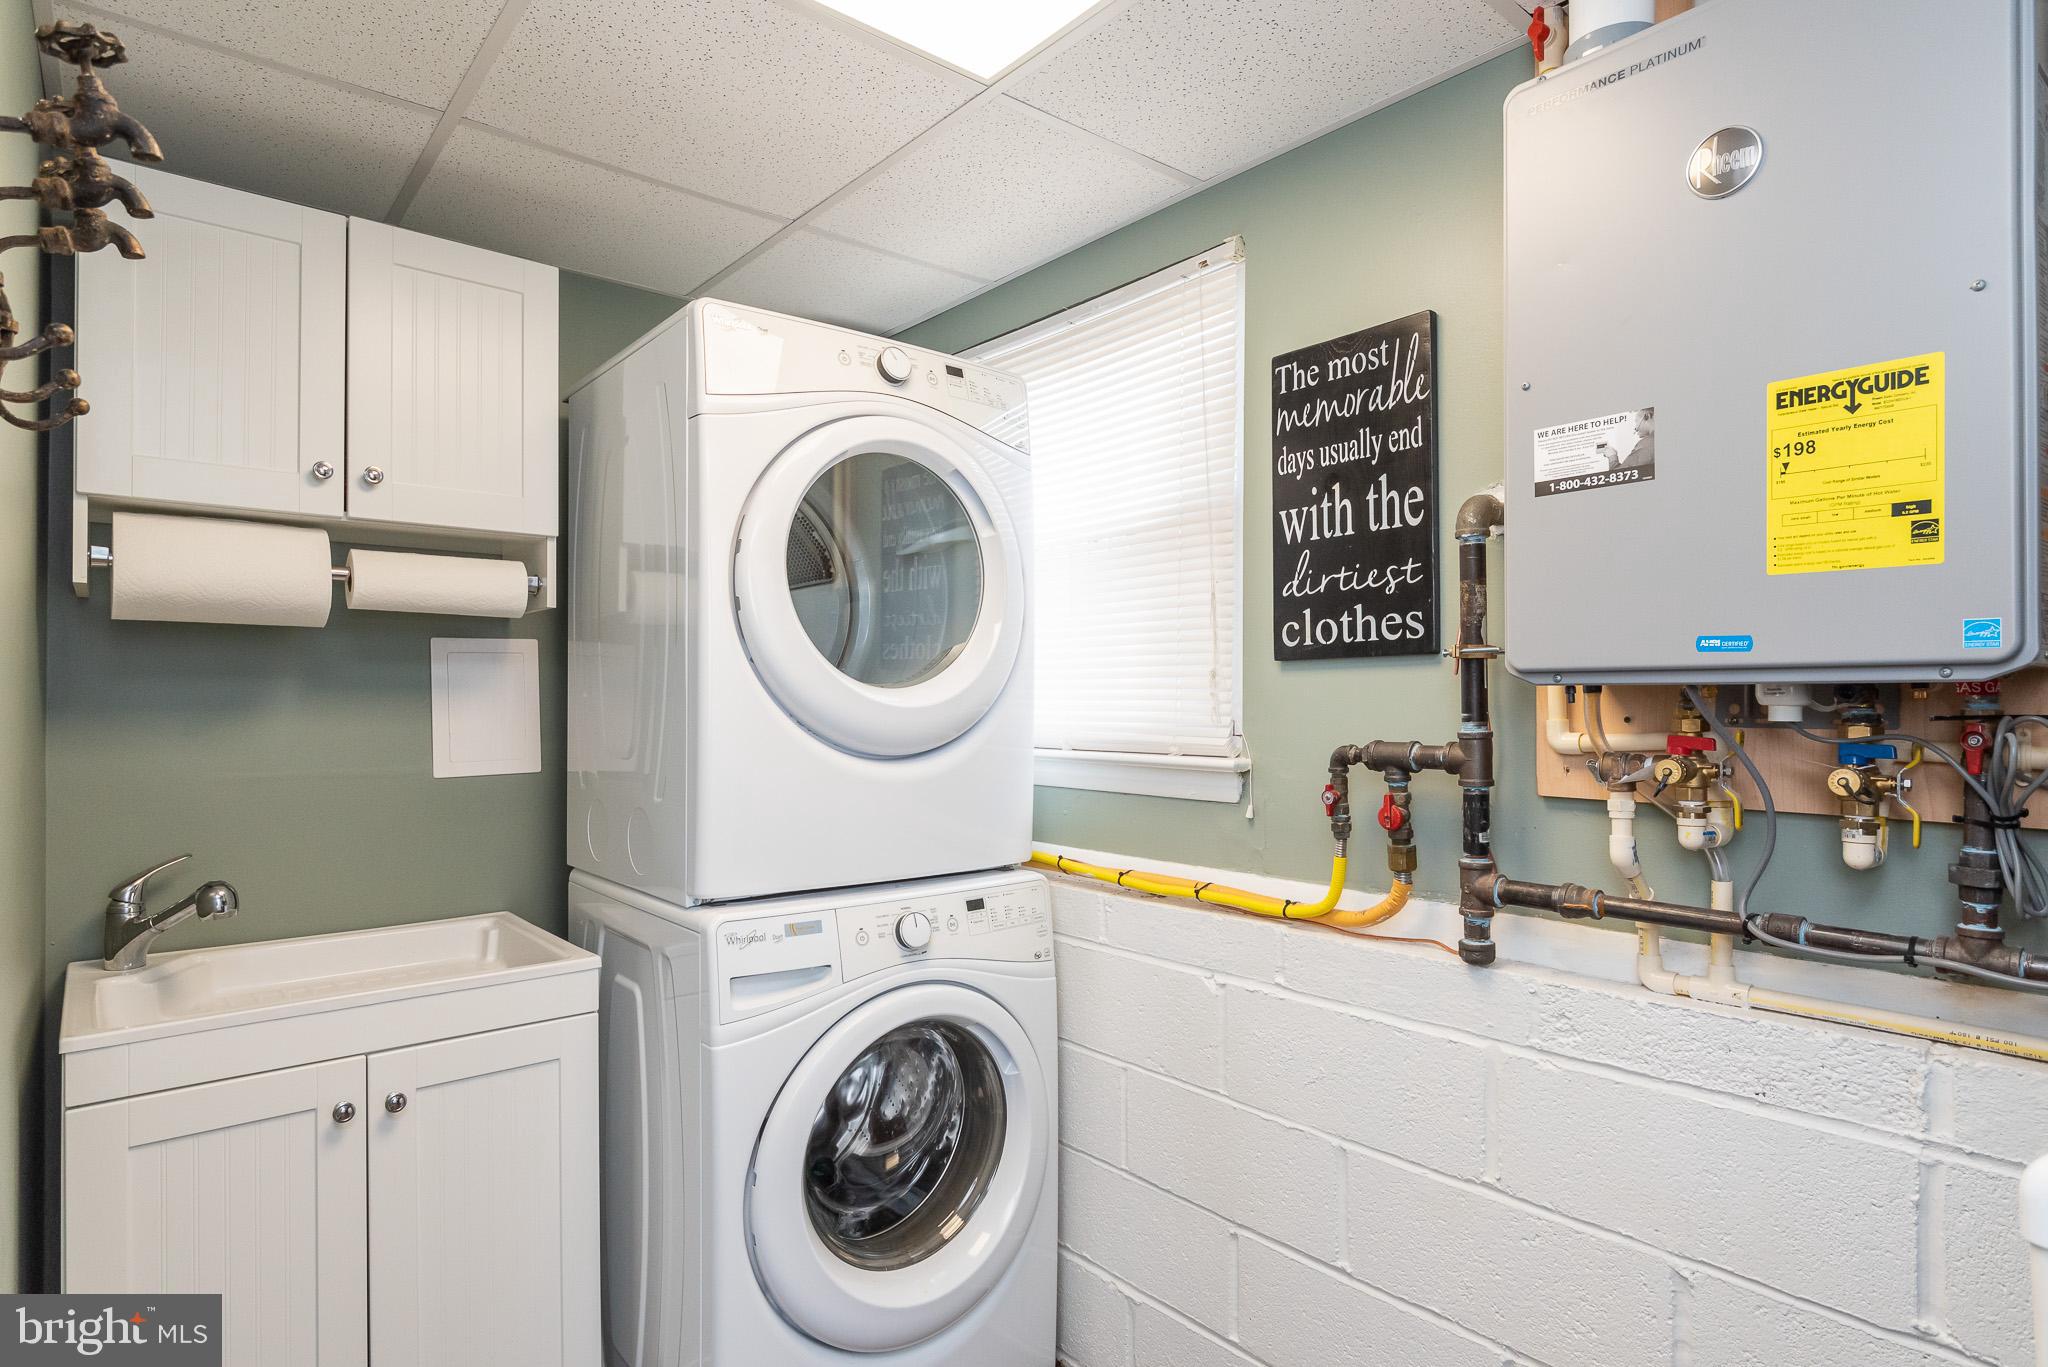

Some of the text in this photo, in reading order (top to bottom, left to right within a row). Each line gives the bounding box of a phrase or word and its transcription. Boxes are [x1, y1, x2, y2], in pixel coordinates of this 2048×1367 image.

[1527, 69, 1626, 117] PERFORMANCE
[1696, 135, 1756, 189] Rheem
[1274, 339, 1390, 395] The most
[1276, 331, 1431, 436] memorable
[1775, 365, 1930, 412] ENERGYGUIDE
[1277, 415, 1423, 480] days usually end
[1537, 430, 1549, 439] WE
[1551, 428, 1566, 437] ARE
[1568, 422, 1588, 433] HERE
[1590, 420, 1602, 429] TO
[1603, 415, 1627, 426] HELP!
[1773, 440, 1816, 458] $198
[1797, 428, 1830, 437] Estimated
[1831, 425, 1852, 434] Yearly
[1853, 421, 1876, 430] Energy
[1549, 469, 1639, 492] 1-800-432-8373
[1279, 473, 1424, 545] with the
[1282, 549, 1424, 598] dirtiest
[1281, 603, 1425, 648] clothes
[726, 932, 767, 946] Whirlpool
